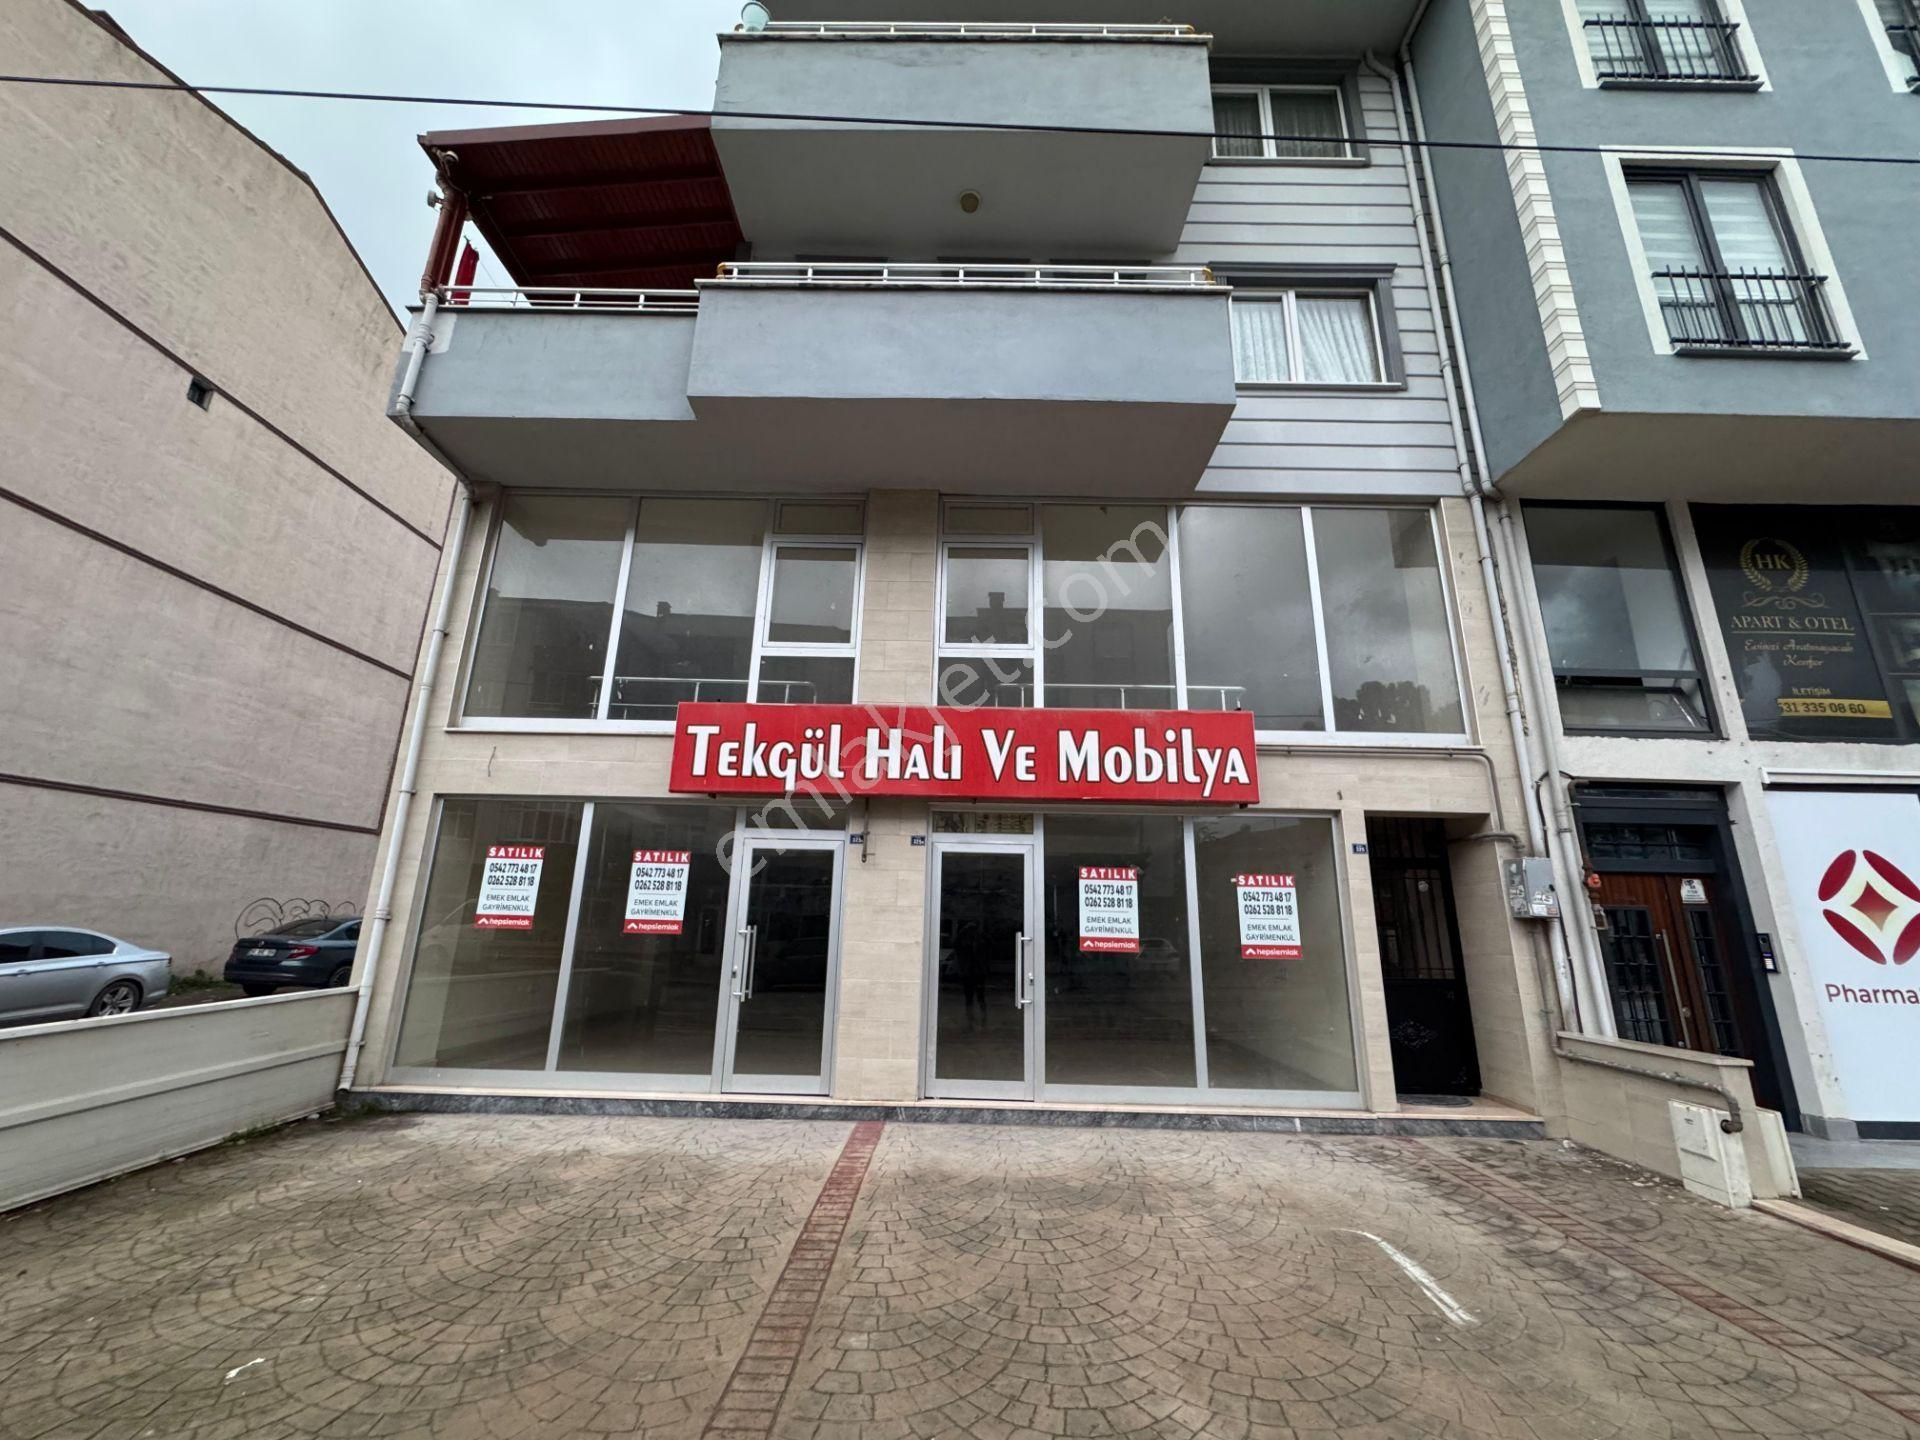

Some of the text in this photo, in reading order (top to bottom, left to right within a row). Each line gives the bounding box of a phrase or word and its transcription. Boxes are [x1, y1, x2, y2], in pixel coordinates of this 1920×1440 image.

[1756, 553, 1791, 570] HK
[1731, 616, 1855, 630] APART & OTEL
[1803, 703, 1827, 713] 335
[1830, 703, 1846, 713] 08
[1850, 704, 1866, 714] 60
[489, 847, 543, 857] SATILIK
[635, 852, 688, 862] SATILIK
[489, 863, 537, 874] 0542 773 48 17
[636, 868, 684, 878] 0542 773 48 17
[1081, 868, 1135, 879] SATILIK
[488, 876, 534, 886] 0262 528 81 18
[635, 880, 681, 891] 0262 528 81 18
[1239, 875, 1293, 886] SATILIK
[1085, 884, 1133, 895] 0542 773 48 17
[1243, 891, 1291, 902] 0542 773 48 17
[483, 903, 530, 911] GAYRİMENKUL
[1085, 897, 1133, 908] 0262 528 81 18
[631, 908, 678, 916] GAYRİMENKUL
[1244, 905, 1292, 915] 0262 528 81 18
[1085, 925, 1134, 934] GAYRİMENKUL
[1246, 933, 1295, 941] GAYRİMENKUL
